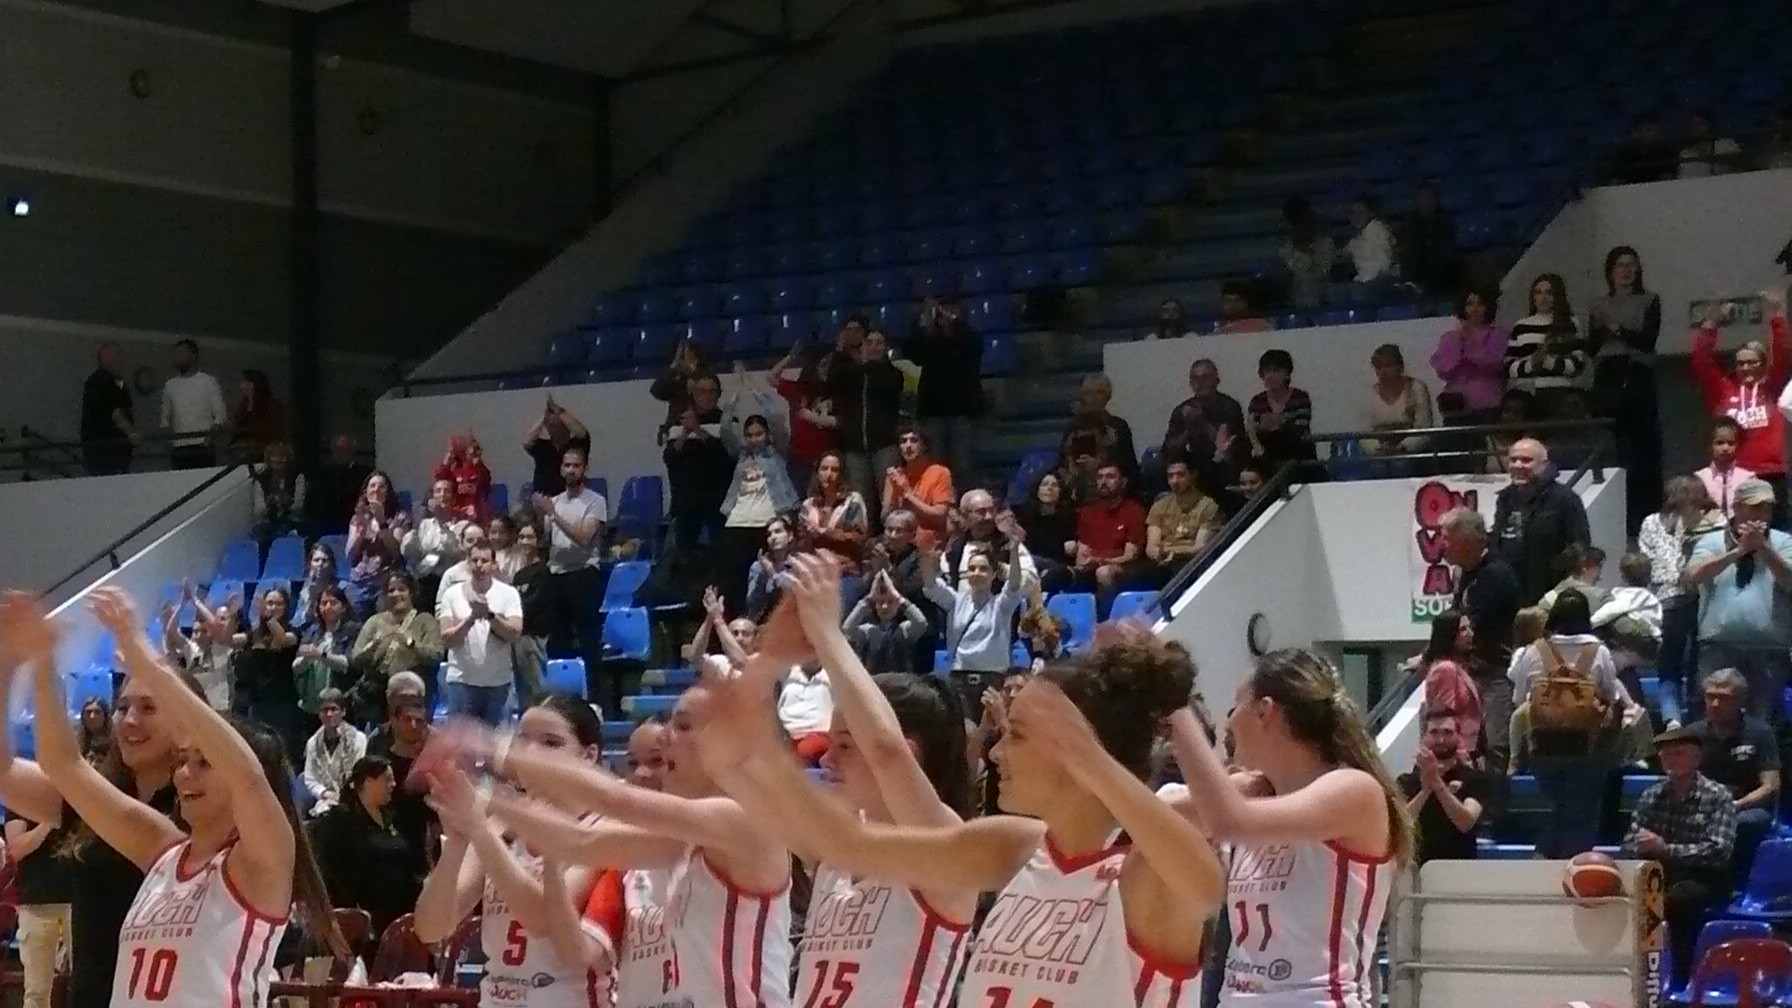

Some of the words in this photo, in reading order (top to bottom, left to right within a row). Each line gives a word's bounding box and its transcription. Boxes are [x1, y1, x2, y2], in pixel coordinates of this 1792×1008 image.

[501, 919, 528, 967] 5
[971, 892, 1108, 966] AUCH
[1234, 899, 1273, 953] 11
[128, 947, 178, 1002] 10
[1036, 965, 1080, 985] CLUB
